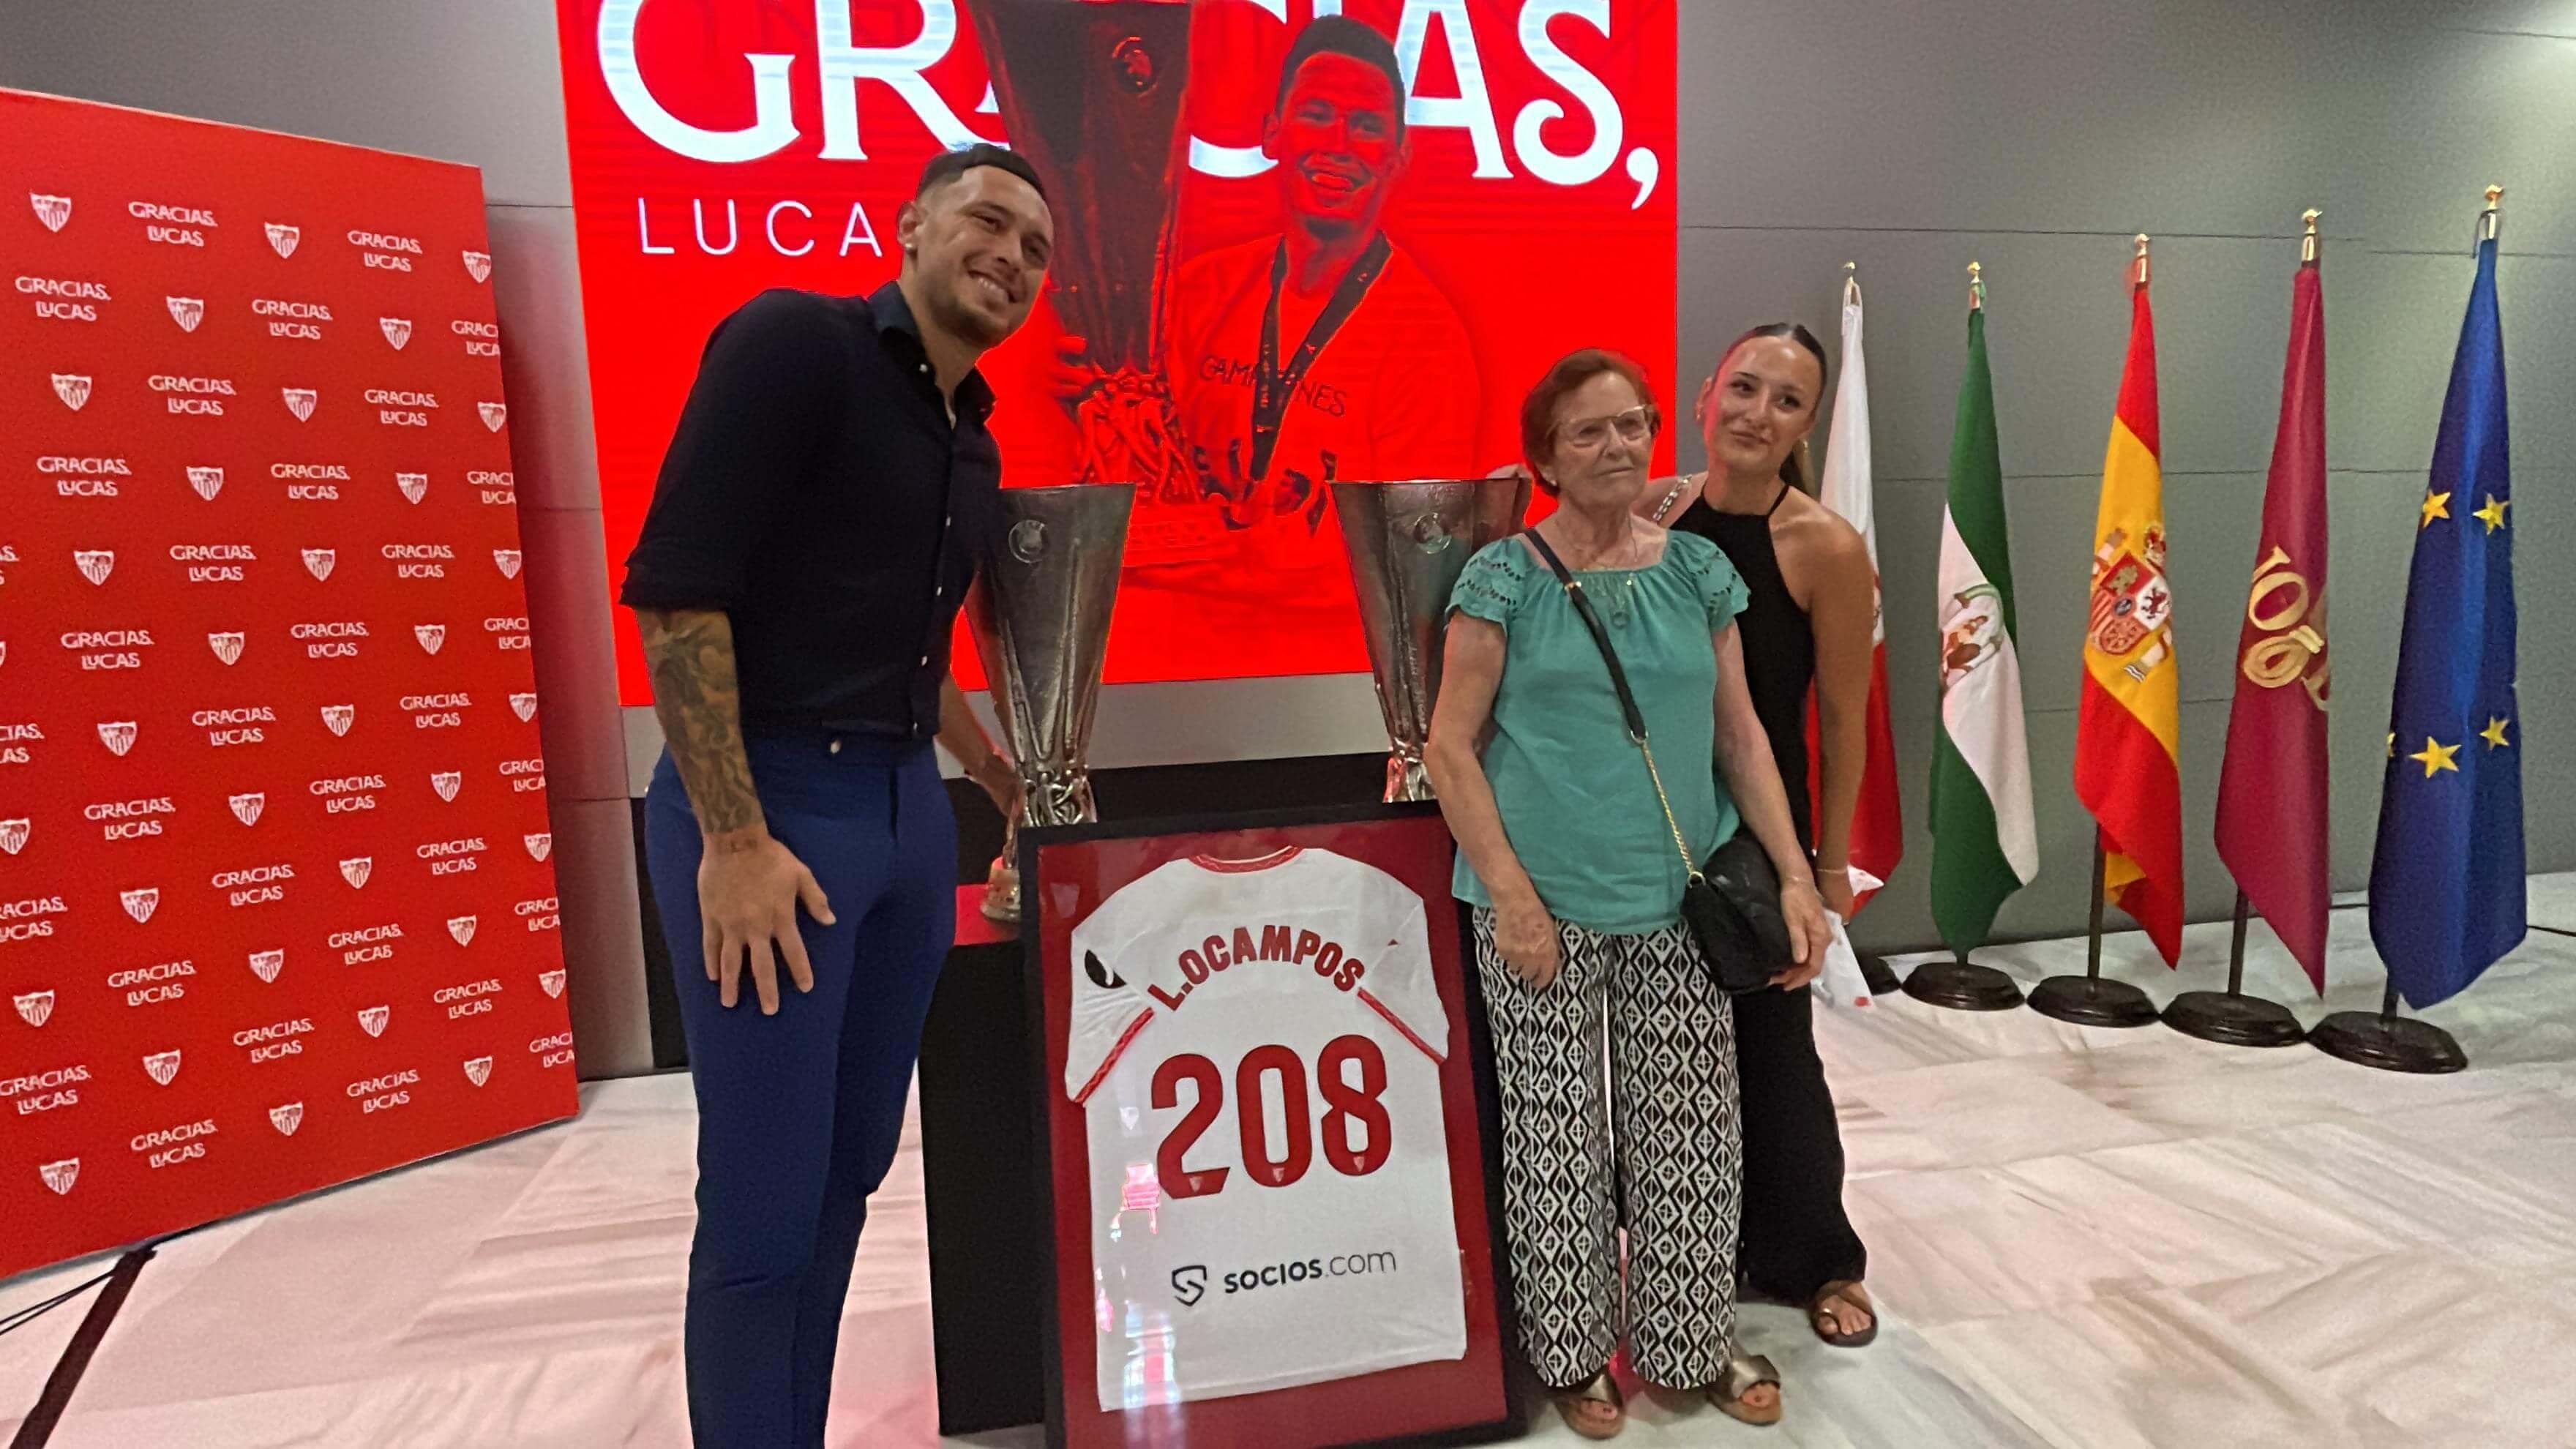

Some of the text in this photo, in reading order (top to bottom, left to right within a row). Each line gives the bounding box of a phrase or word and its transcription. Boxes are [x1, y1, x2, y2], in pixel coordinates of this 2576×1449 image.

[146, 225, 205, 247] LUCAS
[363, 252, 412, 272] LUCAS
[35, 301, 97, 322] LUCAS
[269, 321, 321, 340] LUCAS
[167, 397, 224, 416] LUCAS
[380, 409, 428, 427] LUCAS
[56, 479, 119, 497] LUCAS
[288, 484, 340, 501] LUCAS
[188, 566, 244, 583] LUCAS
[397, 564, 445, 578] LUCAS
[307, 642, 359, 659] LUCAS
[80, 652, 141, 670] LUCAS
[415, 711, 462, 729] LUCAS
[209, 727, 265, 746] LUCAS
[326, 794, 376, 814] LUCAS
[104, 820, 163, 841] LUCAS
[431, 856, 477, 876] LUCAS
[230, 885, 284, 907] LUCAS
[344, 944, 393, 966] LUCAS
[1147, 924, 1366, 1012] L.OCAMPOS
[127, 983, 185, 1007] LUCAS
[448, 998, 493, 1019] LUCAS
[250, 1039, 303, 1064] LUCAS
[16, 1089, 79, 1115] LUCAS
[362, 1090, 411, 1114] LUCAS
[1150, 1034, 1392, 1200] 208
[149, 1142, 206, 1169] LUCAS
